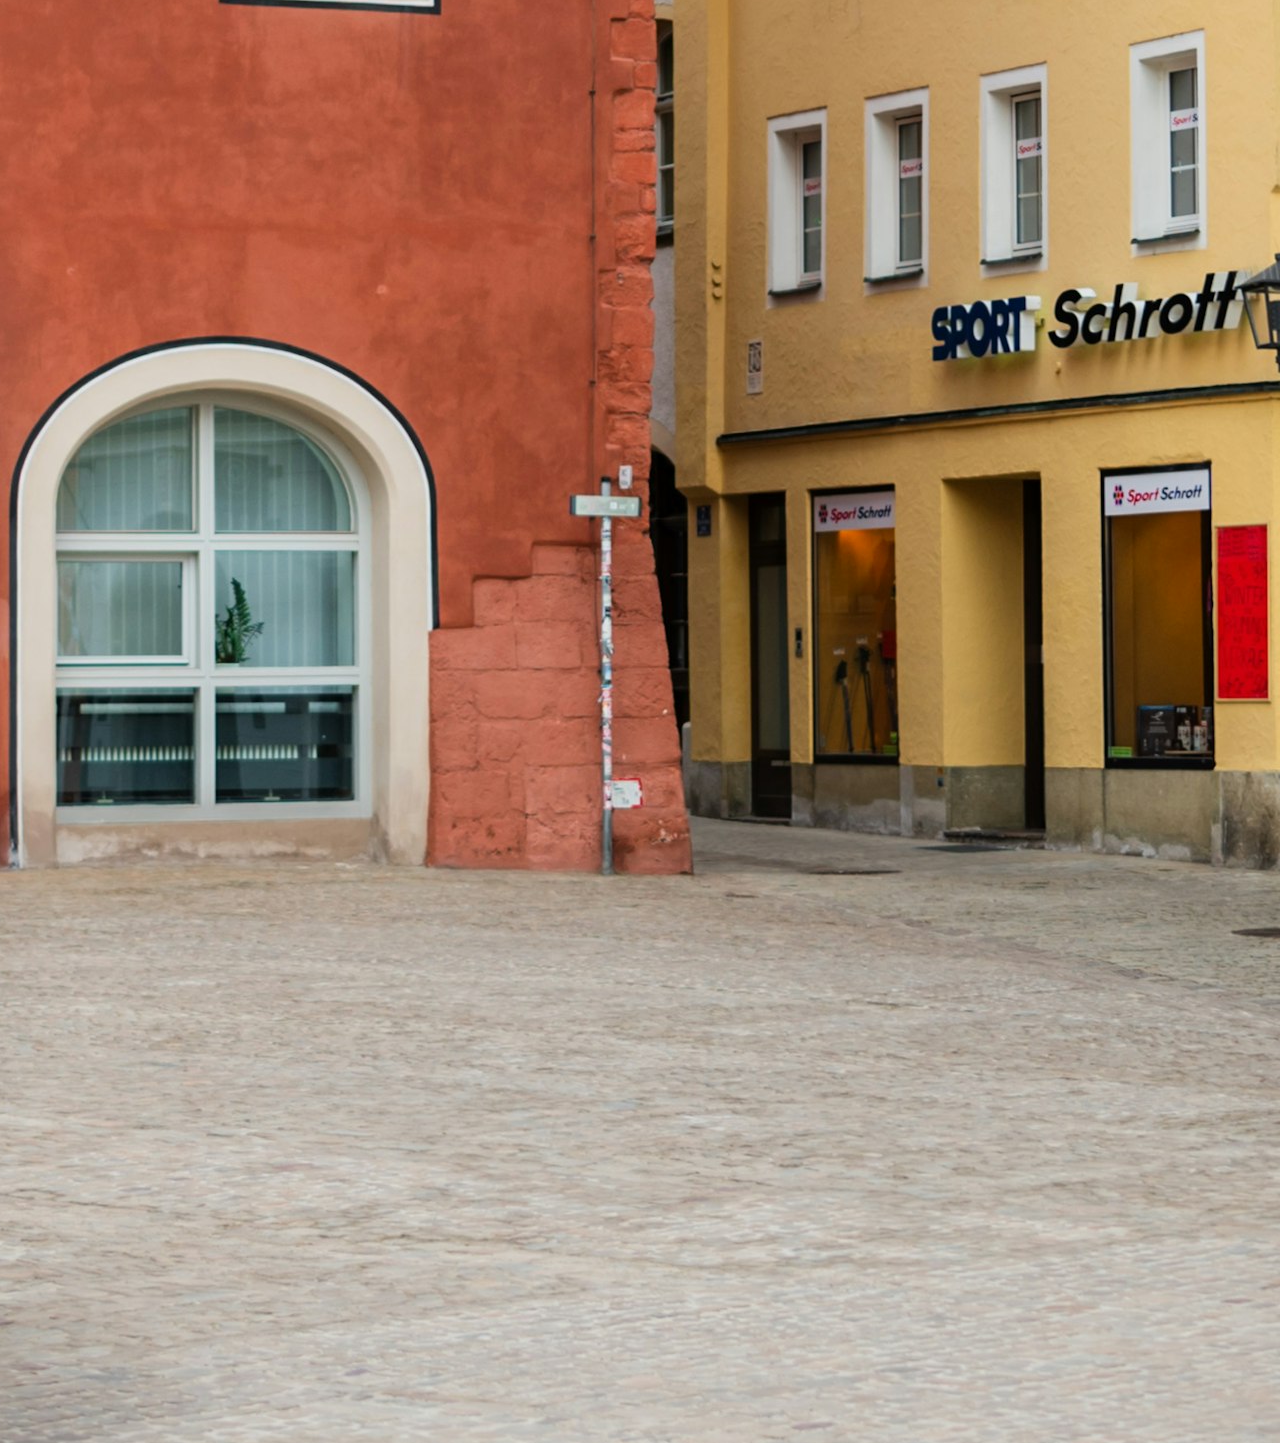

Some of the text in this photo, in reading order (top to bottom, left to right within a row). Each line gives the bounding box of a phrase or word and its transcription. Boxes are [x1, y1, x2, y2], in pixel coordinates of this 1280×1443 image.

[932, 271, 1238, 361] SPORT Schrott
[1127, 485, 1202, 505] Sport Schrott
[831, 504, 892, 523] Sport Schrott
